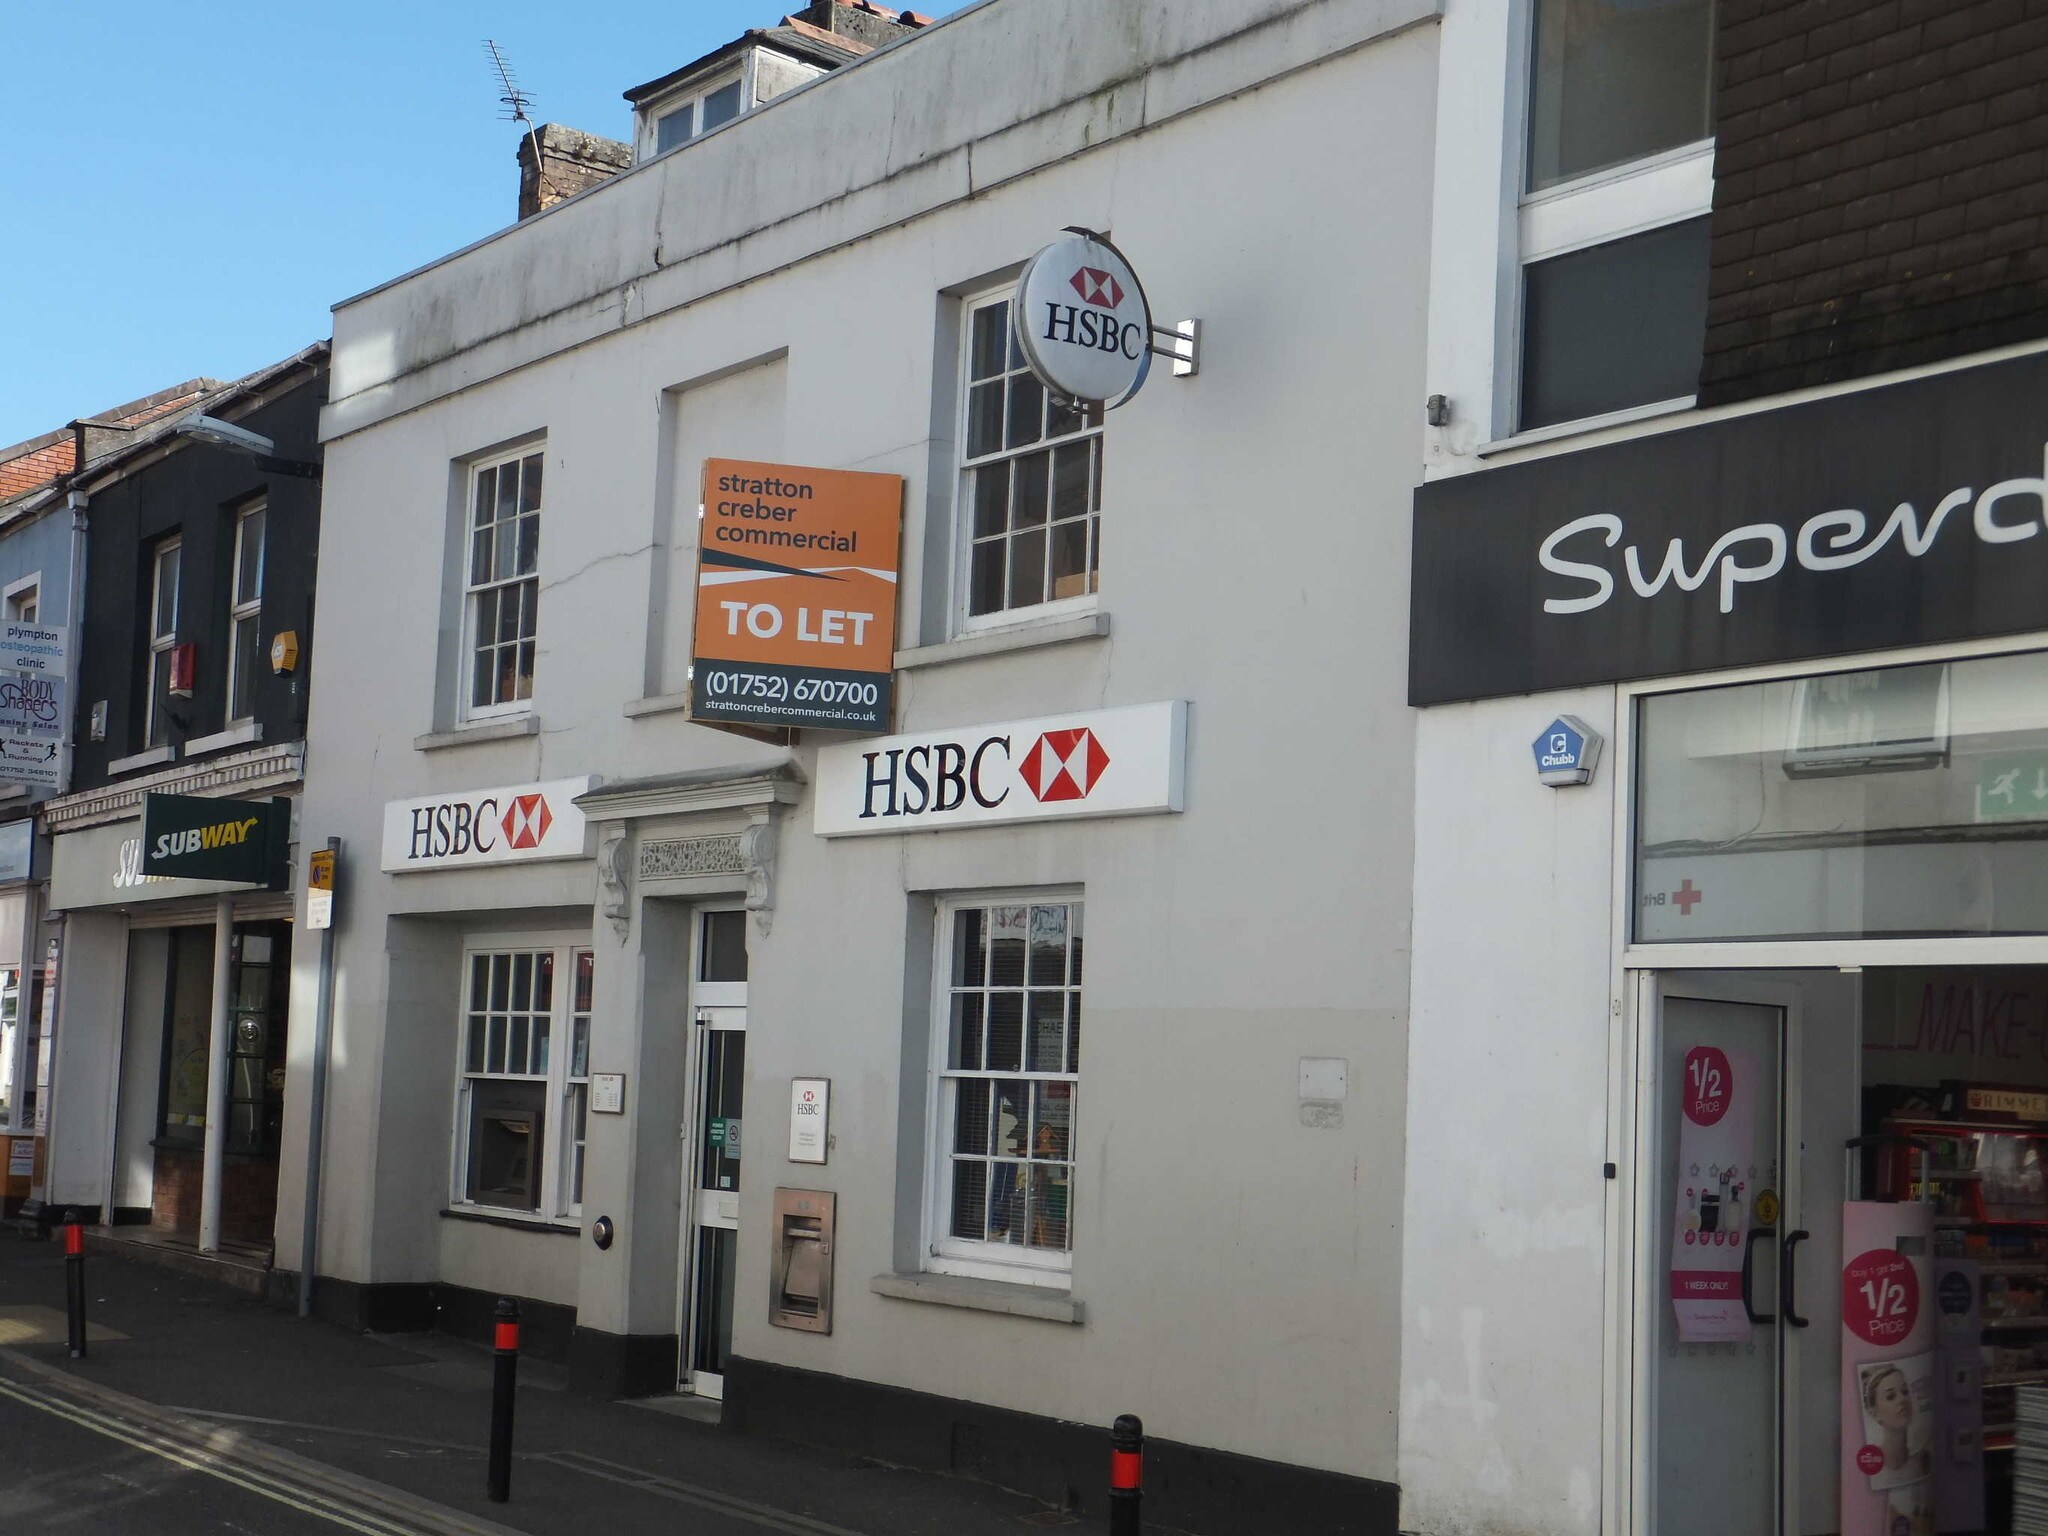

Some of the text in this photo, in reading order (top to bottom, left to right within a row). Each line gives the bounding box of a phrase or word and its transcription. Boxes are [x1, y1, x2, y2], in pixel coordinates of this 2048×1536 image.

[1043, 302, 1141, 360] HSBC
[719, 474, 813, 499] stratton
[717, 498, 797, 522] creber
[716, 524, 857, 552] commercial
[8, 627, 58, 641] plympton
[720, 600, 873, 646] TO LET
[0, 641, 63, 656] osteopathic
[17, 657, 45, 669] clinic
[22, 679, 56, 700] BODY
[706, 671, 877, 706] (01752) 670700
[705, 699, 876, 722] strattoncrebercommercial.co.uk
[32, 721, 59, 730] Salon
[1541, 753, 1575, 766] Chubb
[859, 735, 1011, 818] HSBC
[151, 816, 258, 860] SUBWAY
[408, 798, 498, 859] HSBC
[1689, 1057, 1723, 1100] 1/2
[797, 1103, 820, 1116] HSBC
[1695, 1100, 1720, 1115] Price
[1984, 1093, 2048, 1110] RIMME
[1690, 1281, 1709, 1291] WEEK
[1710, 1281, 1729, 1291] ONLY!
[1859, 1277, 1908, 1318] 1/2
[1868, 1318, 1906, 1337] Price
